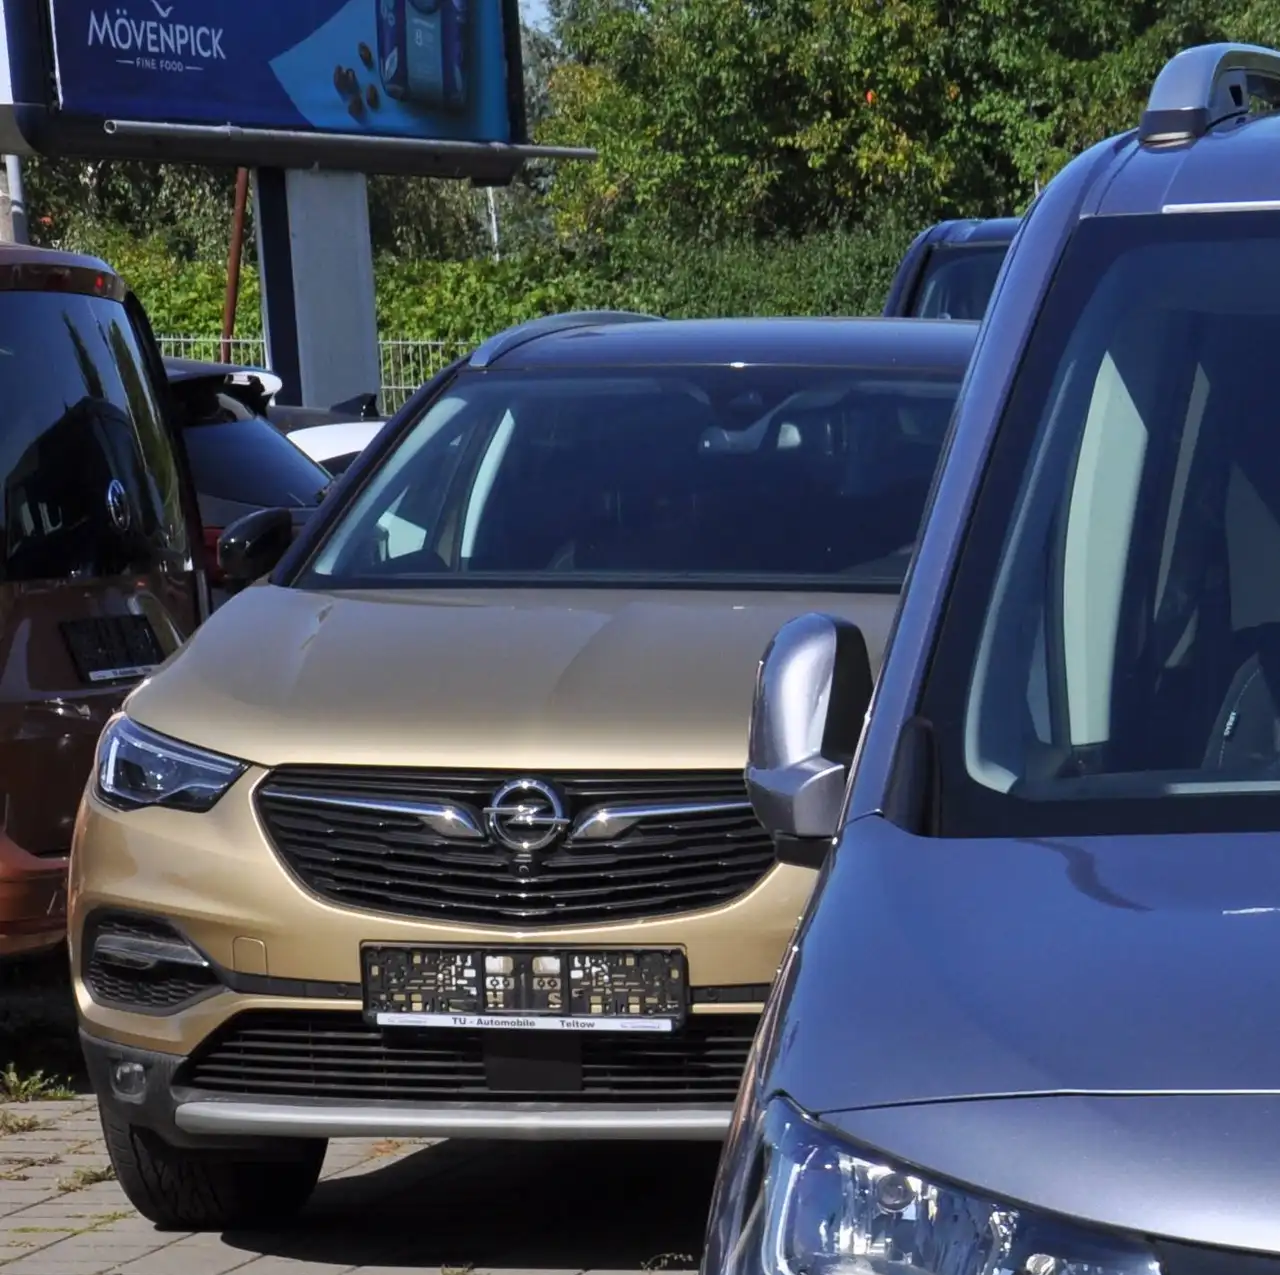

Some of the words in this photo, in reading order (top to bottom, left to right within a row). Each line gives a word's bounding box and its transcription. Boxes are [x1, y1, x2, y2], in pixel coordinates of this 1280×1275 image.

[87, 8, 227, 60] MÖVENPICK
[135, 57, 157, 70] FINE
[159, 60, 184, 72] FOOD
[452, 1017, 467, 1025] TU
[476, 1018, 536, 1027] Automobile
[560, 1019, 596, 1028] Teltow
